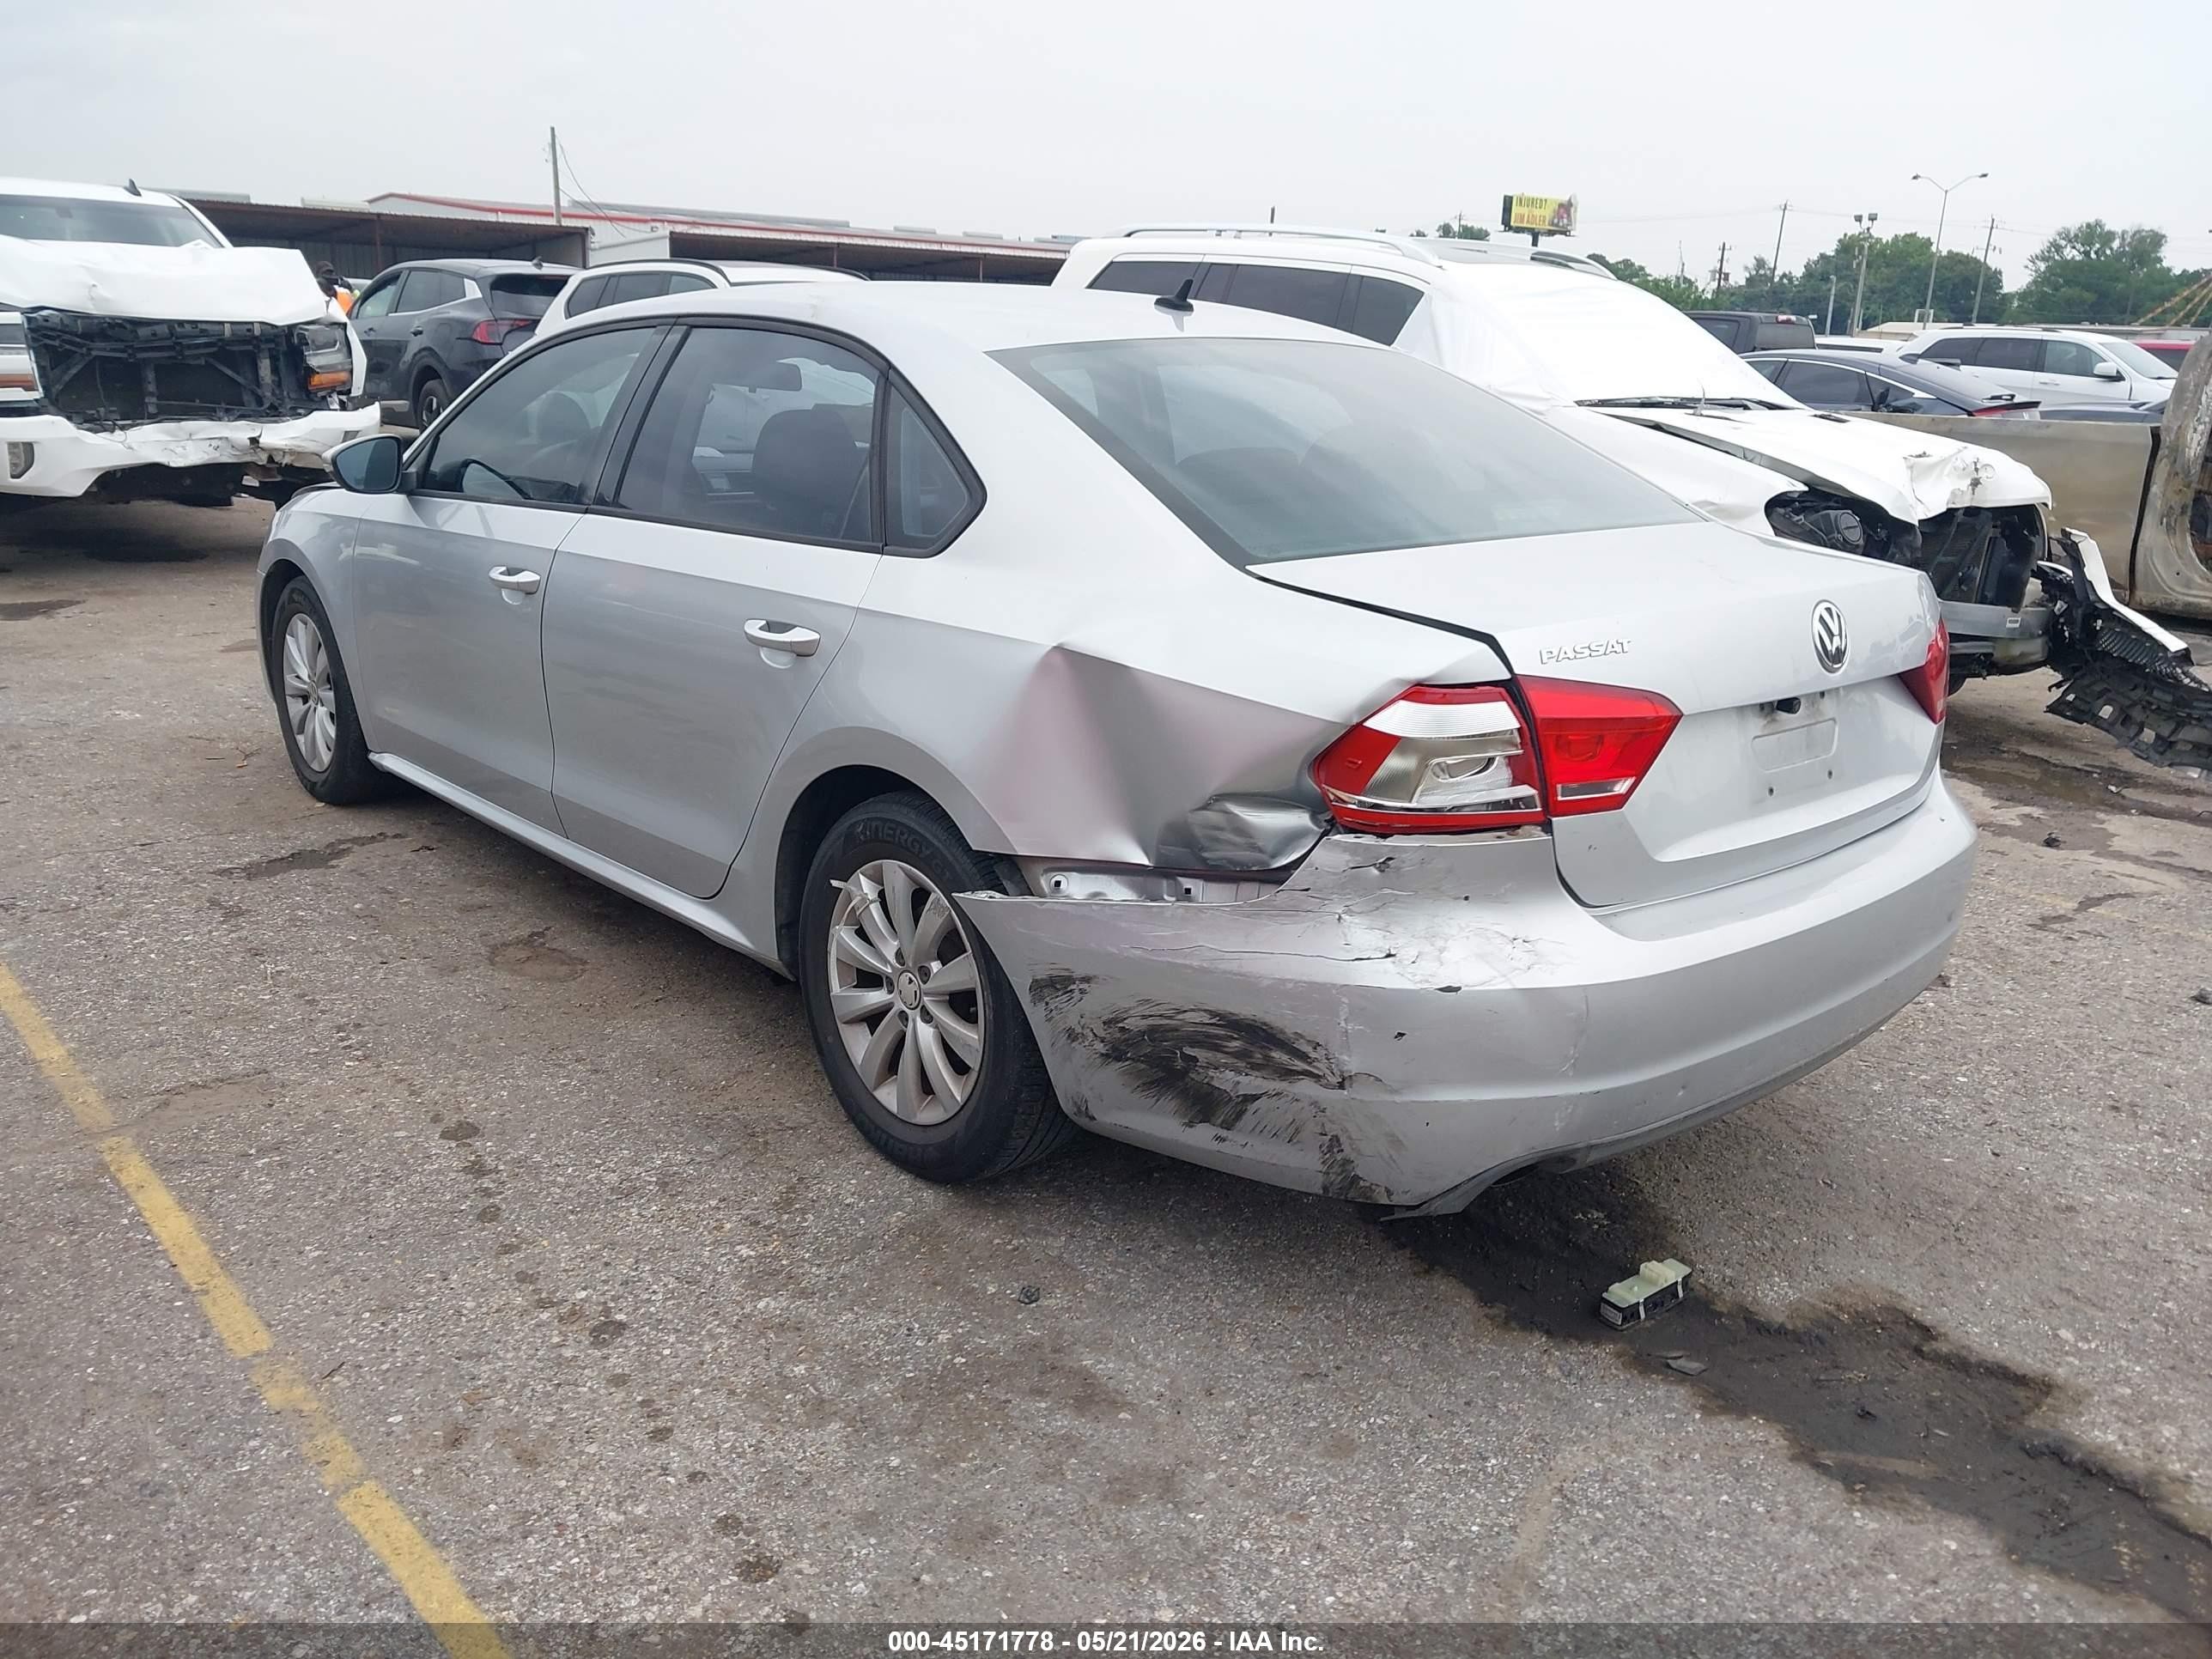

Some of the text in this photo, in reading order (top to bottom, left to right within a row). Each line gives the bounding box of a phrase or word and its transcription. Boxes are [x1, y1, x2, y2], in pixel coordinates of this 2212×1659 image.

[1516, 196, 1547, 210] INJURED?
[1514, 212, 1547, 227] JIM ADLER
[1540, 638, 1632, 665] PASSAT
[854, 818, 933, 859] KINERGY
